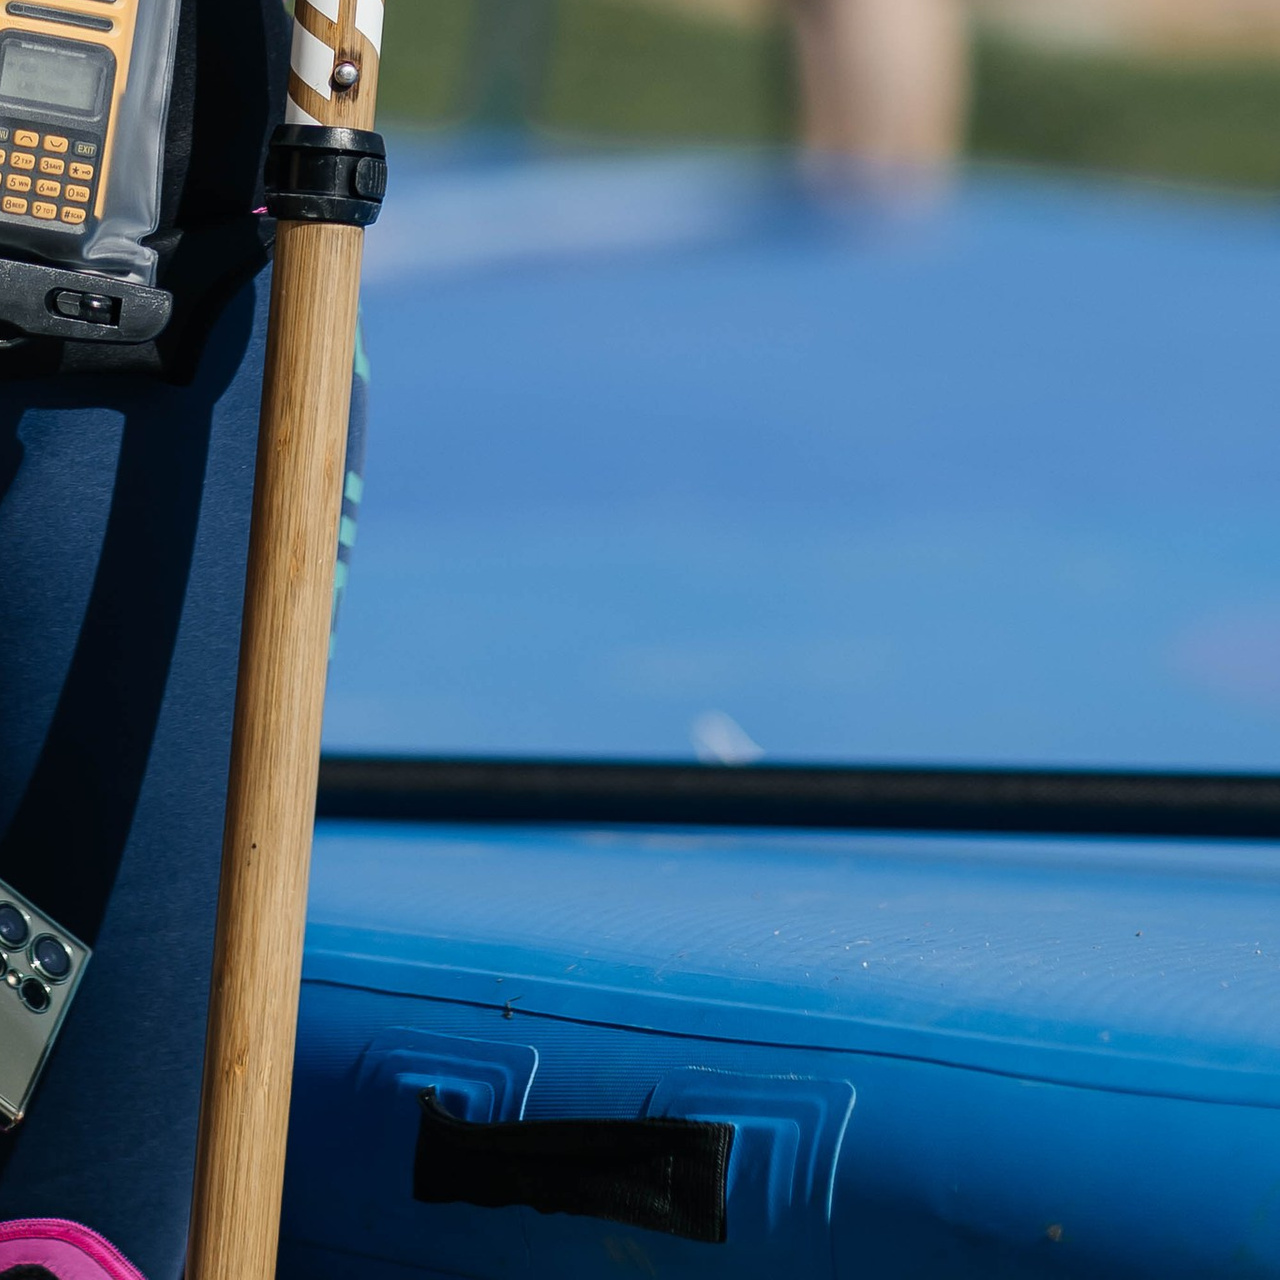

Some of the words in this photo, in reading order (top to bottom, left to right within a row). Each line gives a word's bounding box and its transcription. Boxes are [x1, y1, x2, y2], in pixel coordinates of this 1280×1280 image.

[78, 144, 95, 155] EXIT
[14, 155, 20, 164] 2
[42, 161, 49, 170] 3
[10, 178, 16, 187] 5
[39, 183, 45, 192] 6
[68, 188, 75, 197] 0
[5, 200, 12, 209] 8
[35, 205, 41, 214] 9
